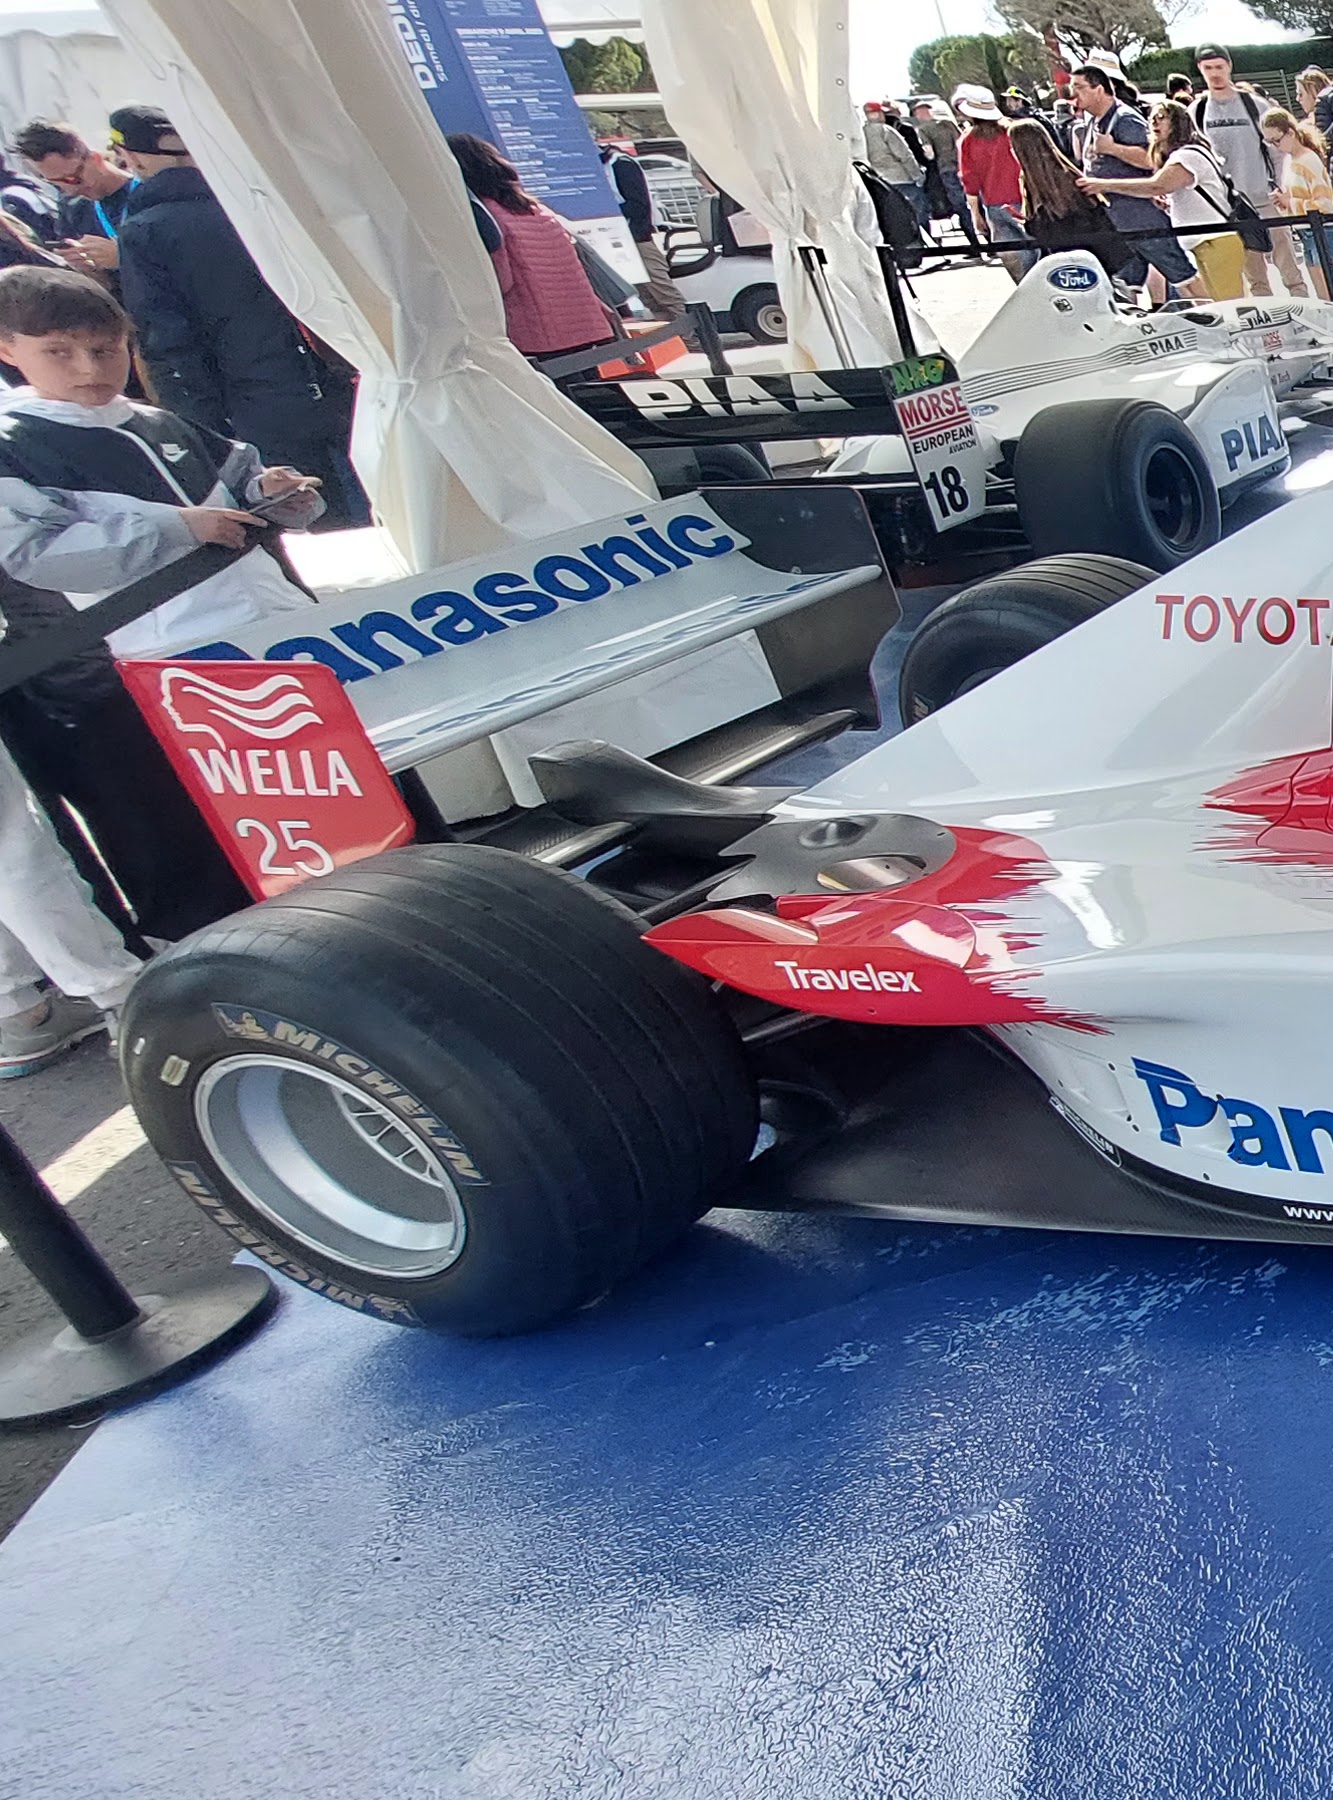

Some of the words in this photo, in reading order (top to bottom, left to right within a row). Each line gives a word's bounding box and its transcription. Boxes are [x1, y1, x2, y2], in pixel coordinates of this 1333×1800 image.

[385, 0, 438, 89] DEDI
[1059, 269, 1092, 288] Ford
[1148, 335, 1185, 356] PIAA
[619, 371, 857, 421] PIAA
[899, 386, 967, 429] MORSE
[912, 423, 974, 455] EUROPEAN
[948, 437, 977, 455] AVIATION
[1220, 410, 1285, 472] PIA
[924, 465, 970, 519] 18
[165, 511, 736, 684] anasonic
[189, 747, 364, 799] WELLA
[237, 819, 335, 878] 25
[774, 961, 922, 993] Travelex
[273, 1020, 484, 1181] MICHELIN
[171, 1164, 368, 1310] MICHELIN
